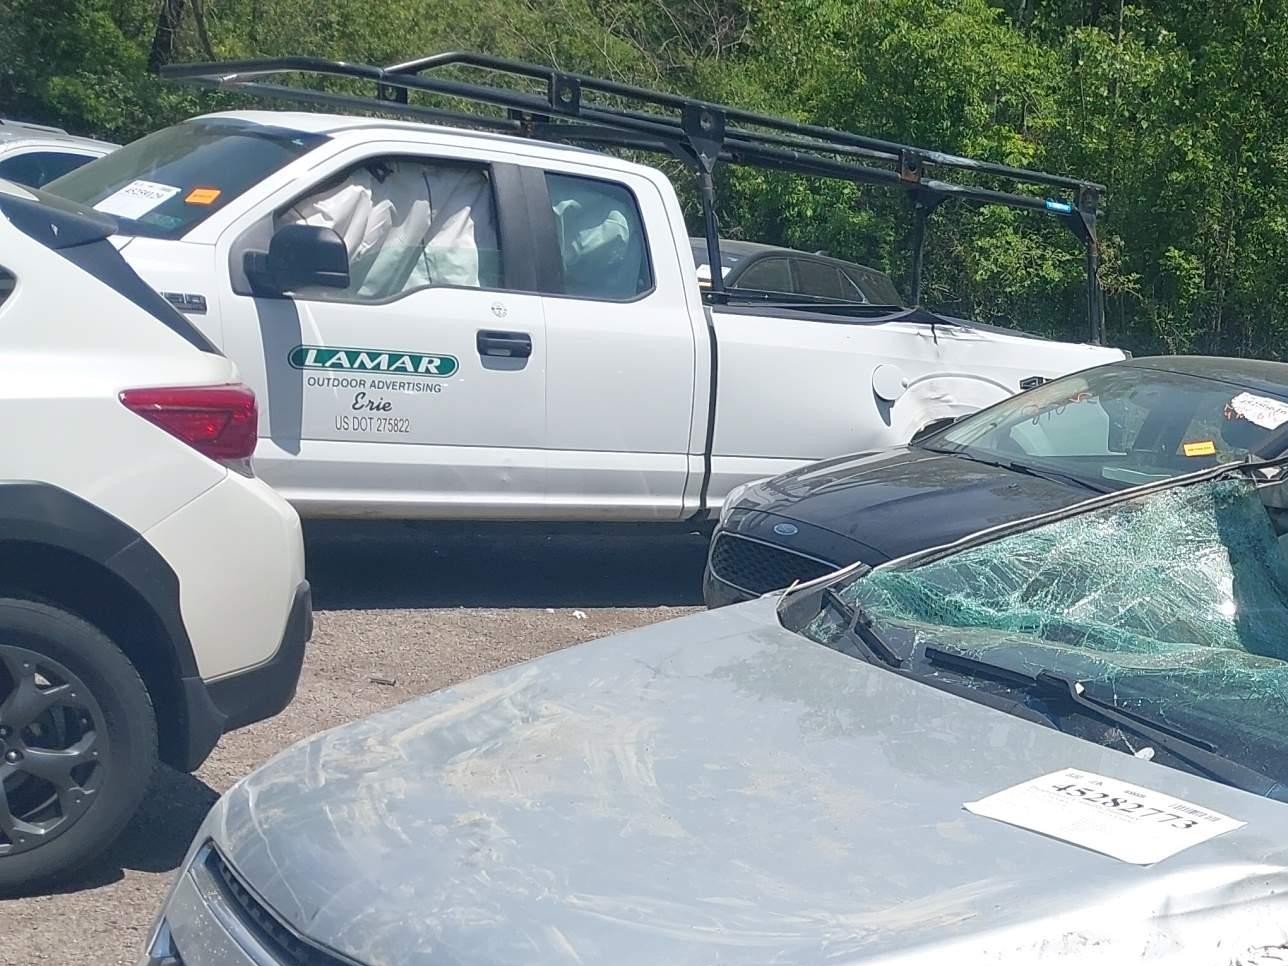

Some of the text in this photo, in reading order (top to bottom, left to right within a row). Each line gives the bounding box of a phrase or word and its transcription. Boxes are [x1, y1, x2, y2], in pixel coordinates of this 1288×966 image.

[303, 348, 442, 375] LAMAR
[307, 376, 442, 393] OUTDOOR ADVERTISING
[352, 392, 393, 412] Erie
[335, 415, 410, 433] US DOT 275822
[1051, 783, 1200, 830] 45282773
